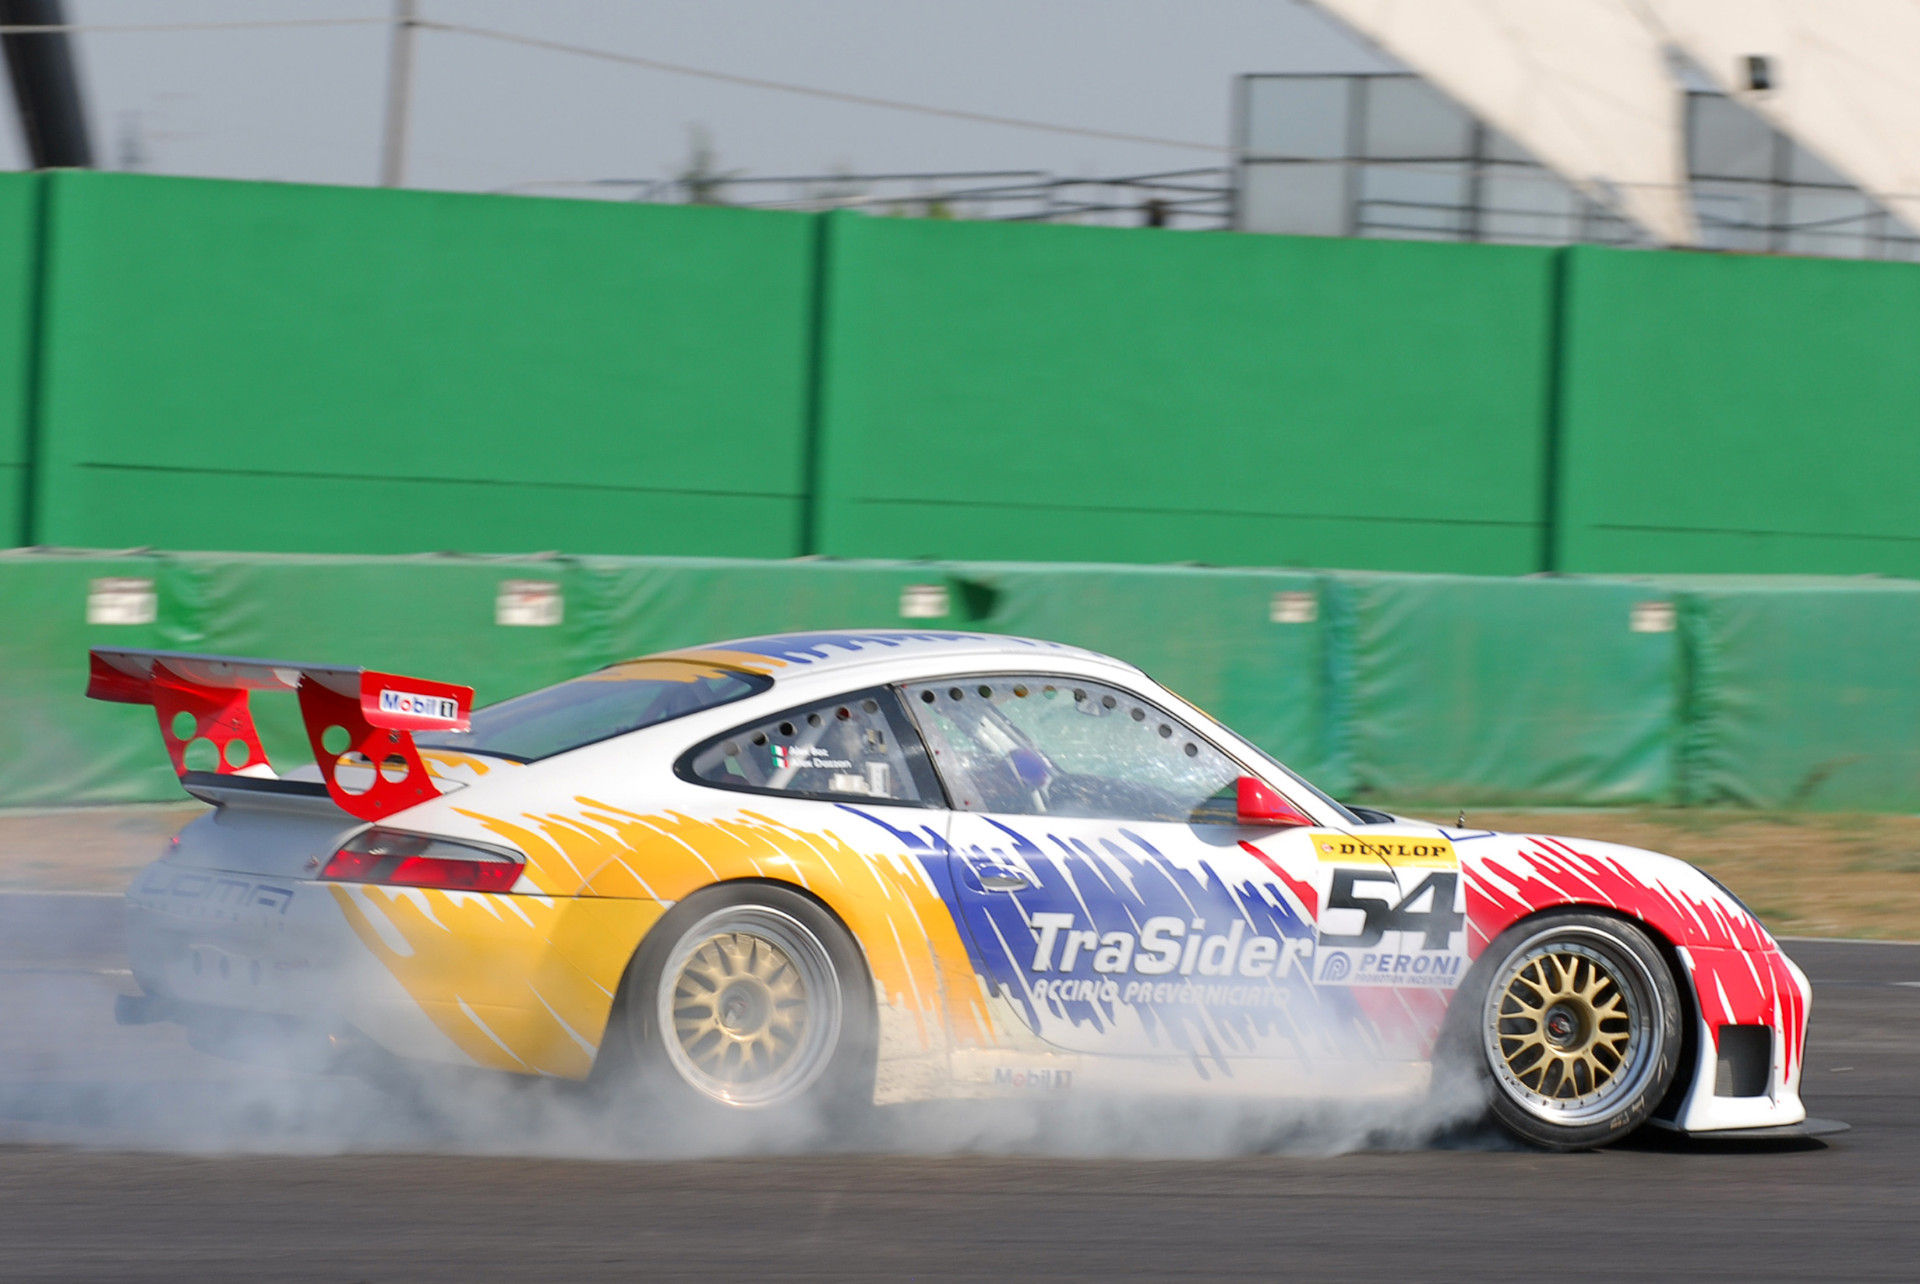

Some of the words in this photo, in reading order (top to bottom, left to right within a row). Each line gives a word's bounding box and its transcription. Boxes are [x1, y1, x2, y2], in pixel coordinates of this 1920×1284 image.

[384, 692, 436, 716] Mobil
[440, 700, 454, 718] 1
[1339, 843, 1447, 857] DUNLOP
[1318, 867, 1466, 950] 54
[1030, 911, 1314, 979] TraSider
[1359, 953, 1462, 975] PERONI
[1033, 979, 1118, 1002] ACCIAIO
[1123, 980, 1292, 1007] PREVERNICIATO
[994, 1068, 1051, 1088] Mobil
